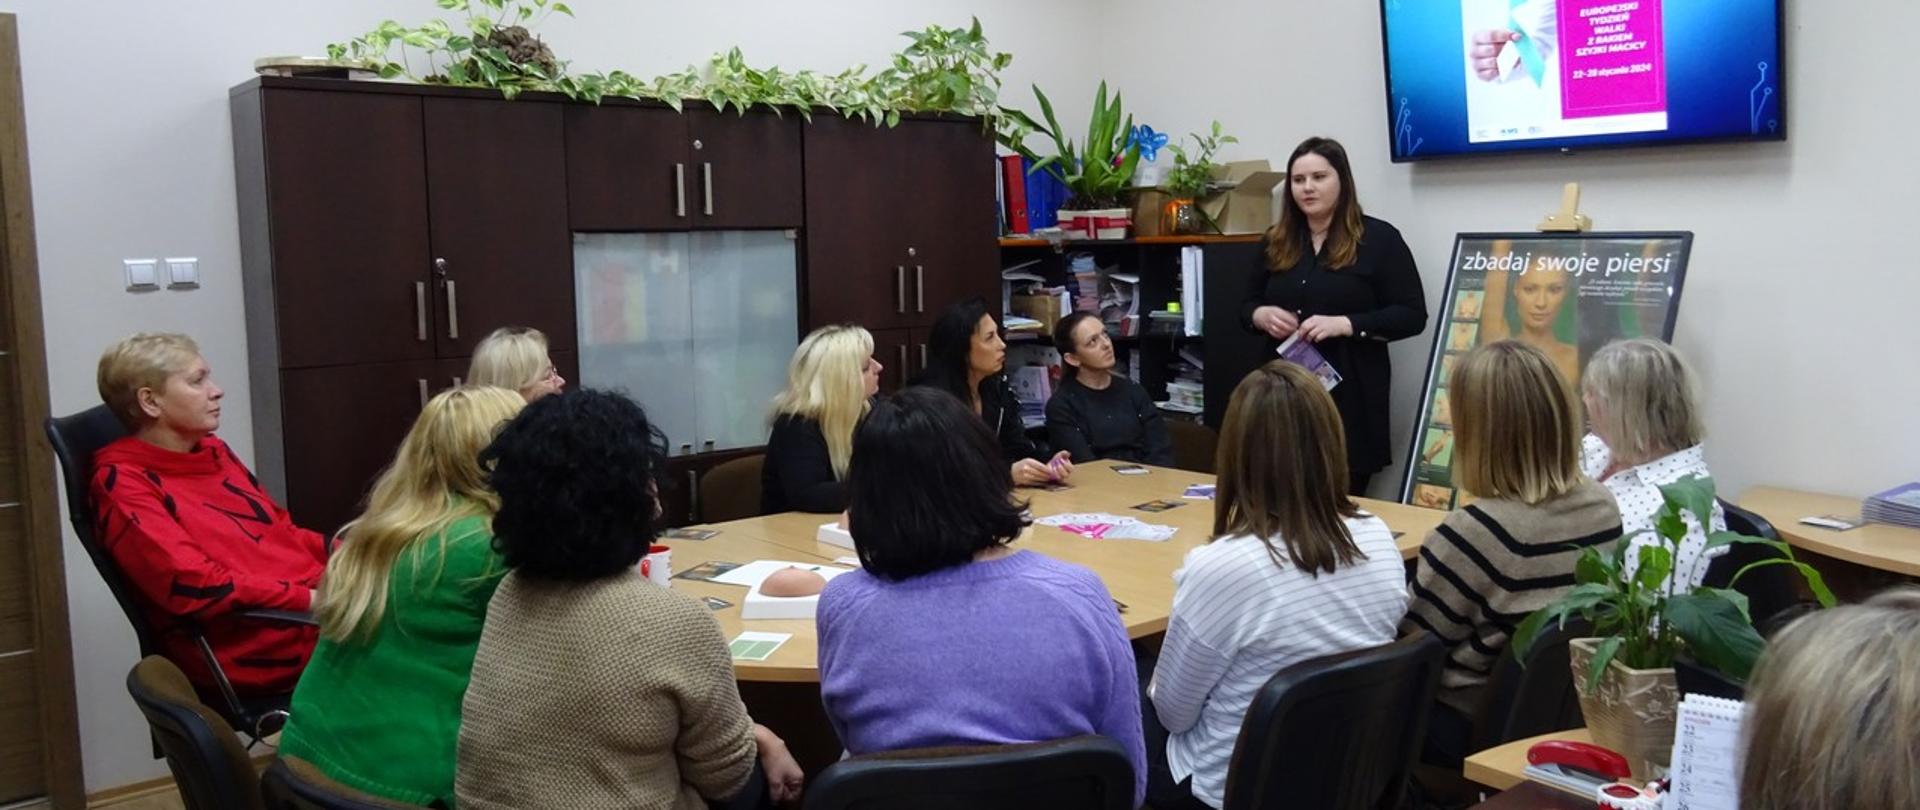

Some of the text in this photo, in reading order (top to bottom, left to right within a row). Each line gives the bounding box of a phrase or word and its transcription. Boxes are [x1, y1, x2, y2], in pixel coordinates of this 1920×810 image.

[1580, 2, 1639, 17] EUROPEJSKI
[1594, 23, 1626, 34] WALKI
[1595, 32, 1634, 44] RAKIEM
[1576, 41, 1647, 56] SZYJKI MACICY
[1463, 251, 1672, 277] zbadaj swoje piersi
